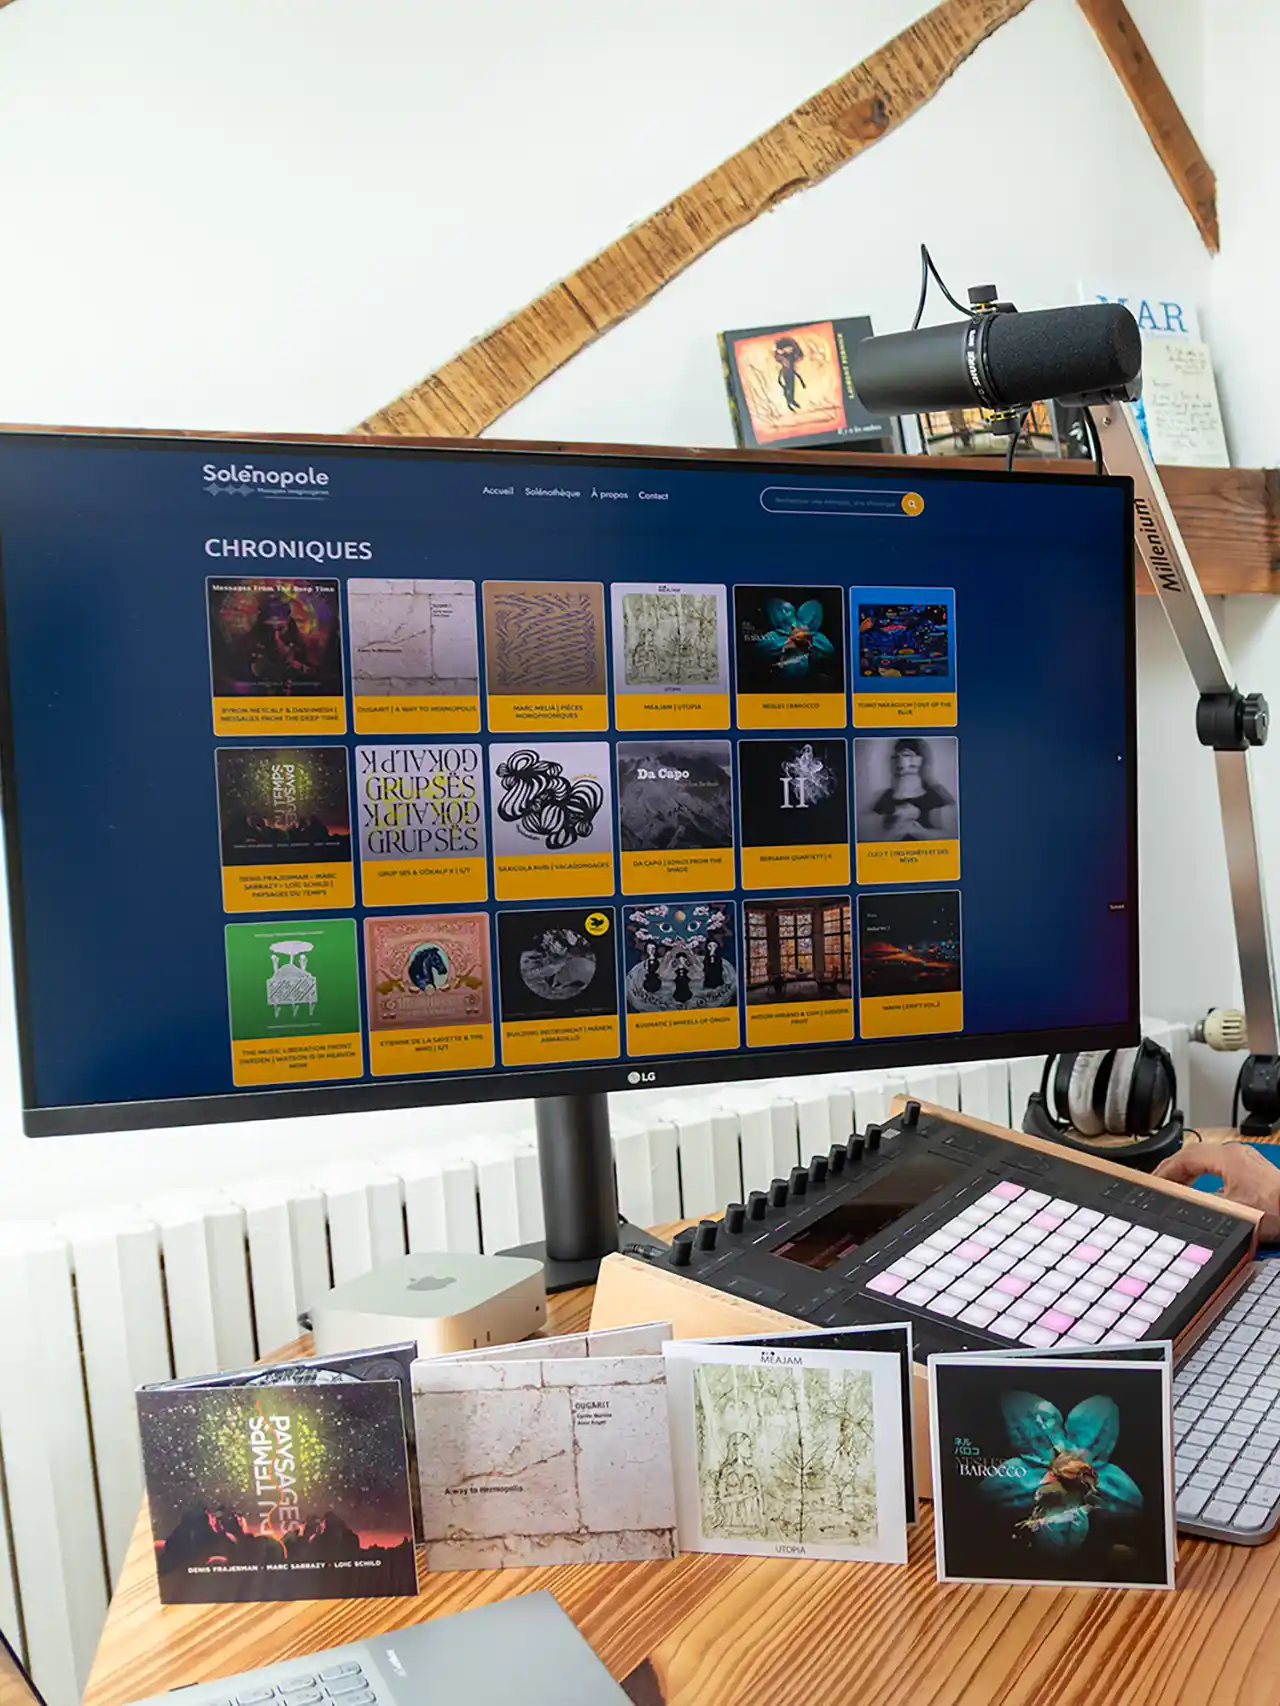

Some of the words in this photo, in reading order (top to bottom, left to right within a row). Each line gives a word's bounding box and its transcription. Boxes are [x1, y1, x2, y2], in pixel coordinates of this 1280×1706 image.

[1096, 294, 1189, 332] AR
[482, 486, 514, 496] Accueil
[600, 490, 628, 500] propos
[638, 490, 669, 500] Contact
[205, 538, 372, 563] CHRONIQUES
[1134, 498, 1181, 593] Millenium
[637, 768, 656, 780] Da
[658, 768, 690, 780] Capo
[271, 764, 285, 807] TEMPS
[366, 776, 430, 802] GRUP
[368, 828, 433, 855] GRUP
[641, 1072, 656, 1082] LG
[575, 1401, 610, 1410] OUGARIT
[248, 1415, 279, 1496] TEMPS
[269, 1415, 300, 1532] PAYSAGES
[960, 1463, 1028, 1478] BAROCCO
[444, 1488, 450, 1496] A
[452, 1488, 468, 1496] way
[470, 1484, 478, 1494] to
[775, 1545, 807, 1554] UTOPIA
[188, 1566, 211, 1574] DENIS
[212, 1564, 258, 1573] FRAJERMAN
[266, 1563, 288, 1571] MARC
[290, 1562, 326, 1570] SARRAZY
[354, 1560, 382, 1568] SCHILD
